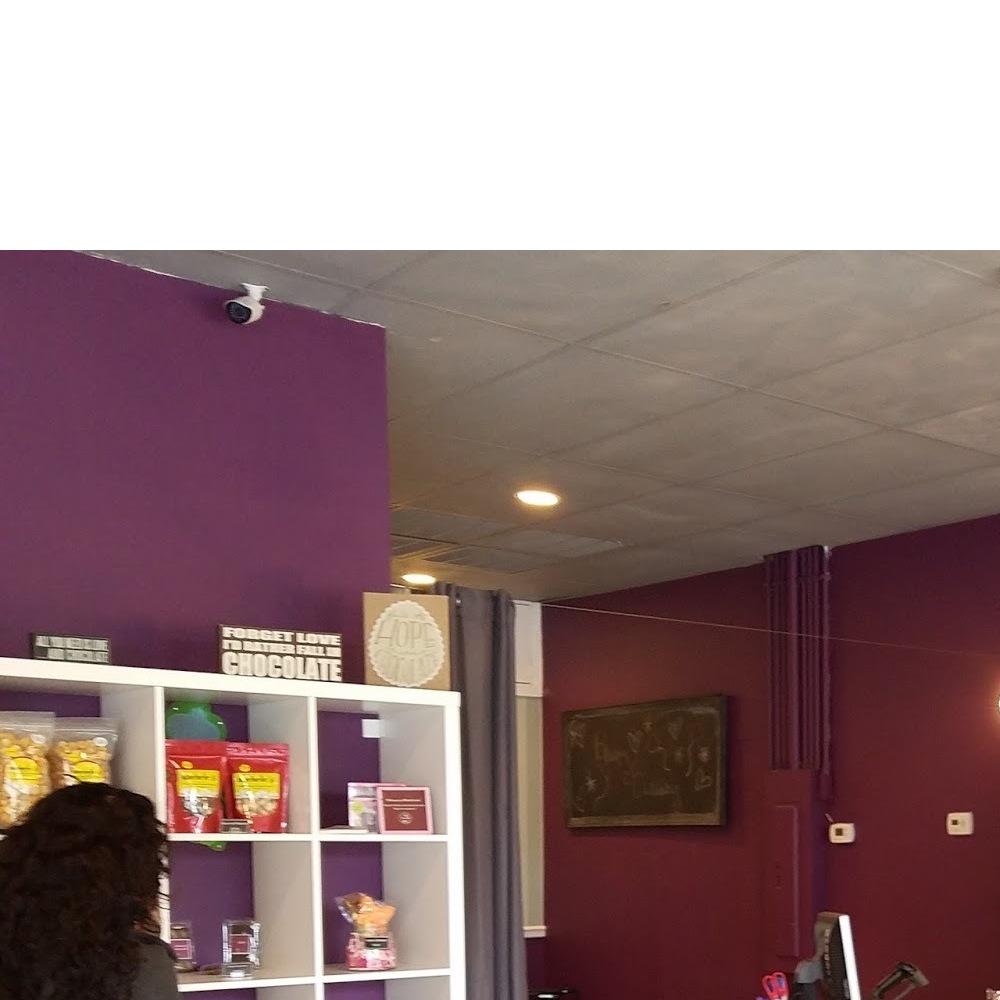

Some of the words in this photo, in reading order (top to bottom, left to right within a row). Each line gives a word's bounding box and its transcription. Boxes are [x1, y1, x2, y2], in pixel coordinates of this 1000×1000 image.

[222, 626, 295, 643] FORGET
[296, 632, 341, 646] LOVE
[242, 640, 296, 655] RATHER
[296, 645, 326, 657] FALL
[222, 651, 342, 682] CHOCOLATE
